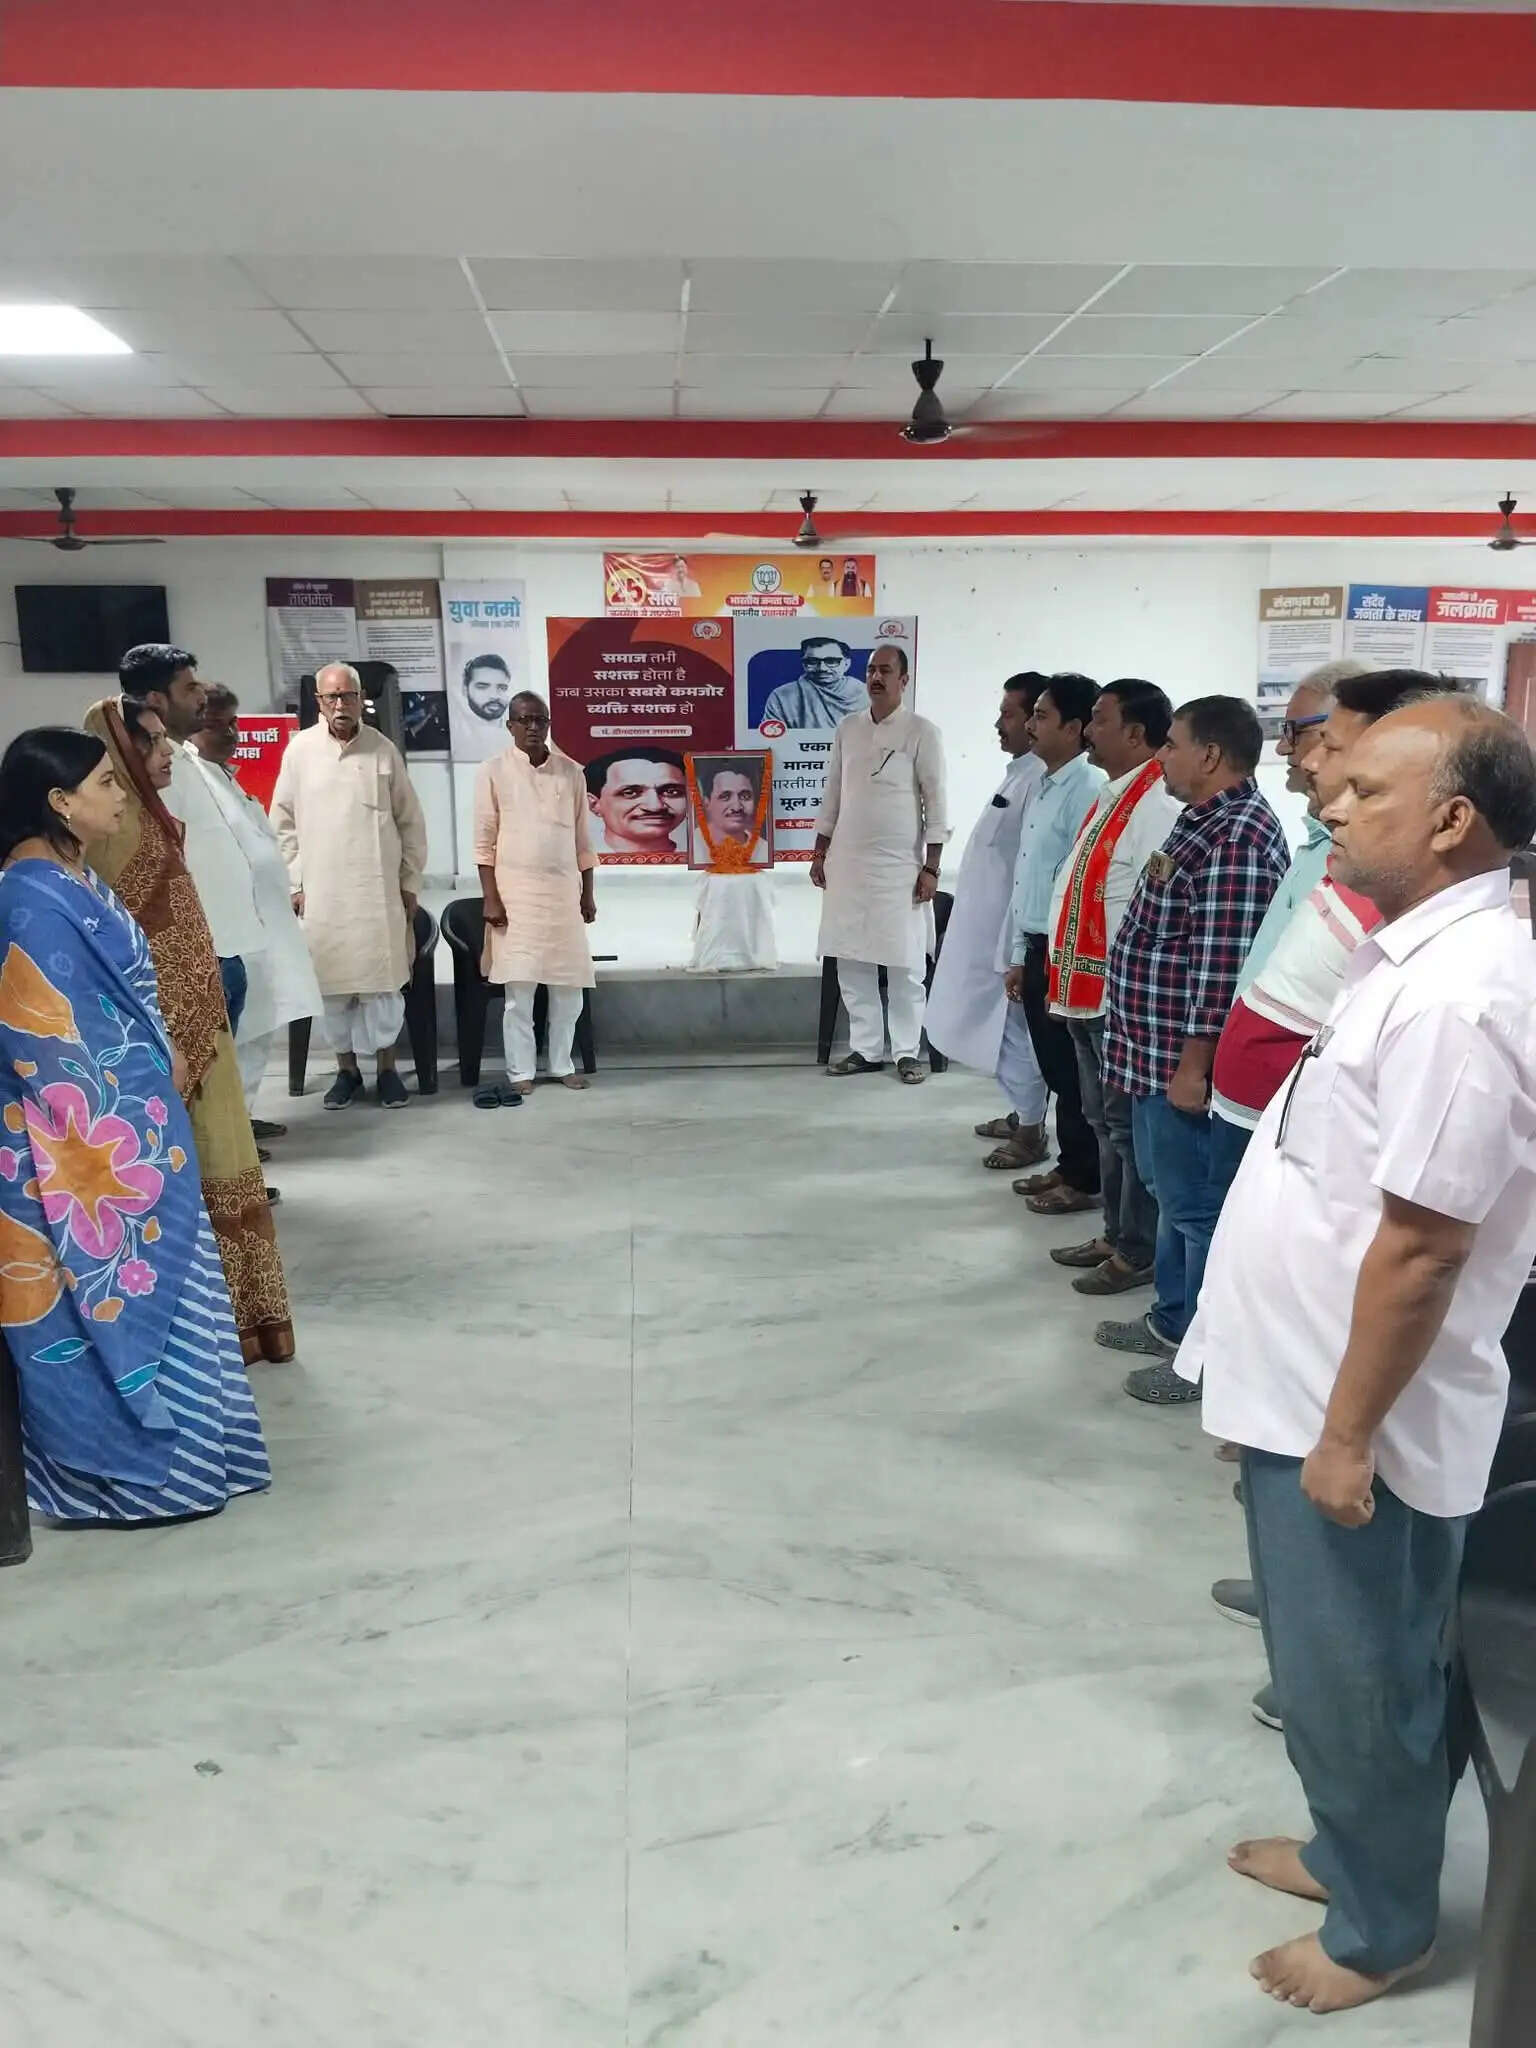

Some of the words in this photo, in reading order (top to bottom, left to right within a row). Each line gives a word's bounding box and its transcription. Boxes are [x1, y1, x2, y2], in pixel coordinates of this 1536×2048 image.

[448, 601, 480, 623] युवा
[483, 596, 521, 617] नमो
[1436, 598, 1499, 619] जलक्रांति
[601, 653, 648, 663] समाज
[650, 650, 677, 663] तभी
[593, 670, 640, 681] सशक्त
[642, 667, 673, 681] होता
[675, 666, 687, 681] है
[555, 687, 579, 697] जब
[583, 687, 624, 697] उसका
[628, 685, 666, 697] सबसे
[670, 684, 725, 697] कमजोर
[586, 702, 629, 714] व्यक्ति
[631, 703, 676, 714] सशक्त
[679, 701, 695, 715] हो
[252, 728, 279, 743] पार्टी
[799, 742, 834, 752] एका
[783, 761, 825, 770] मानव
[780, 797, 807, 811] मूल
